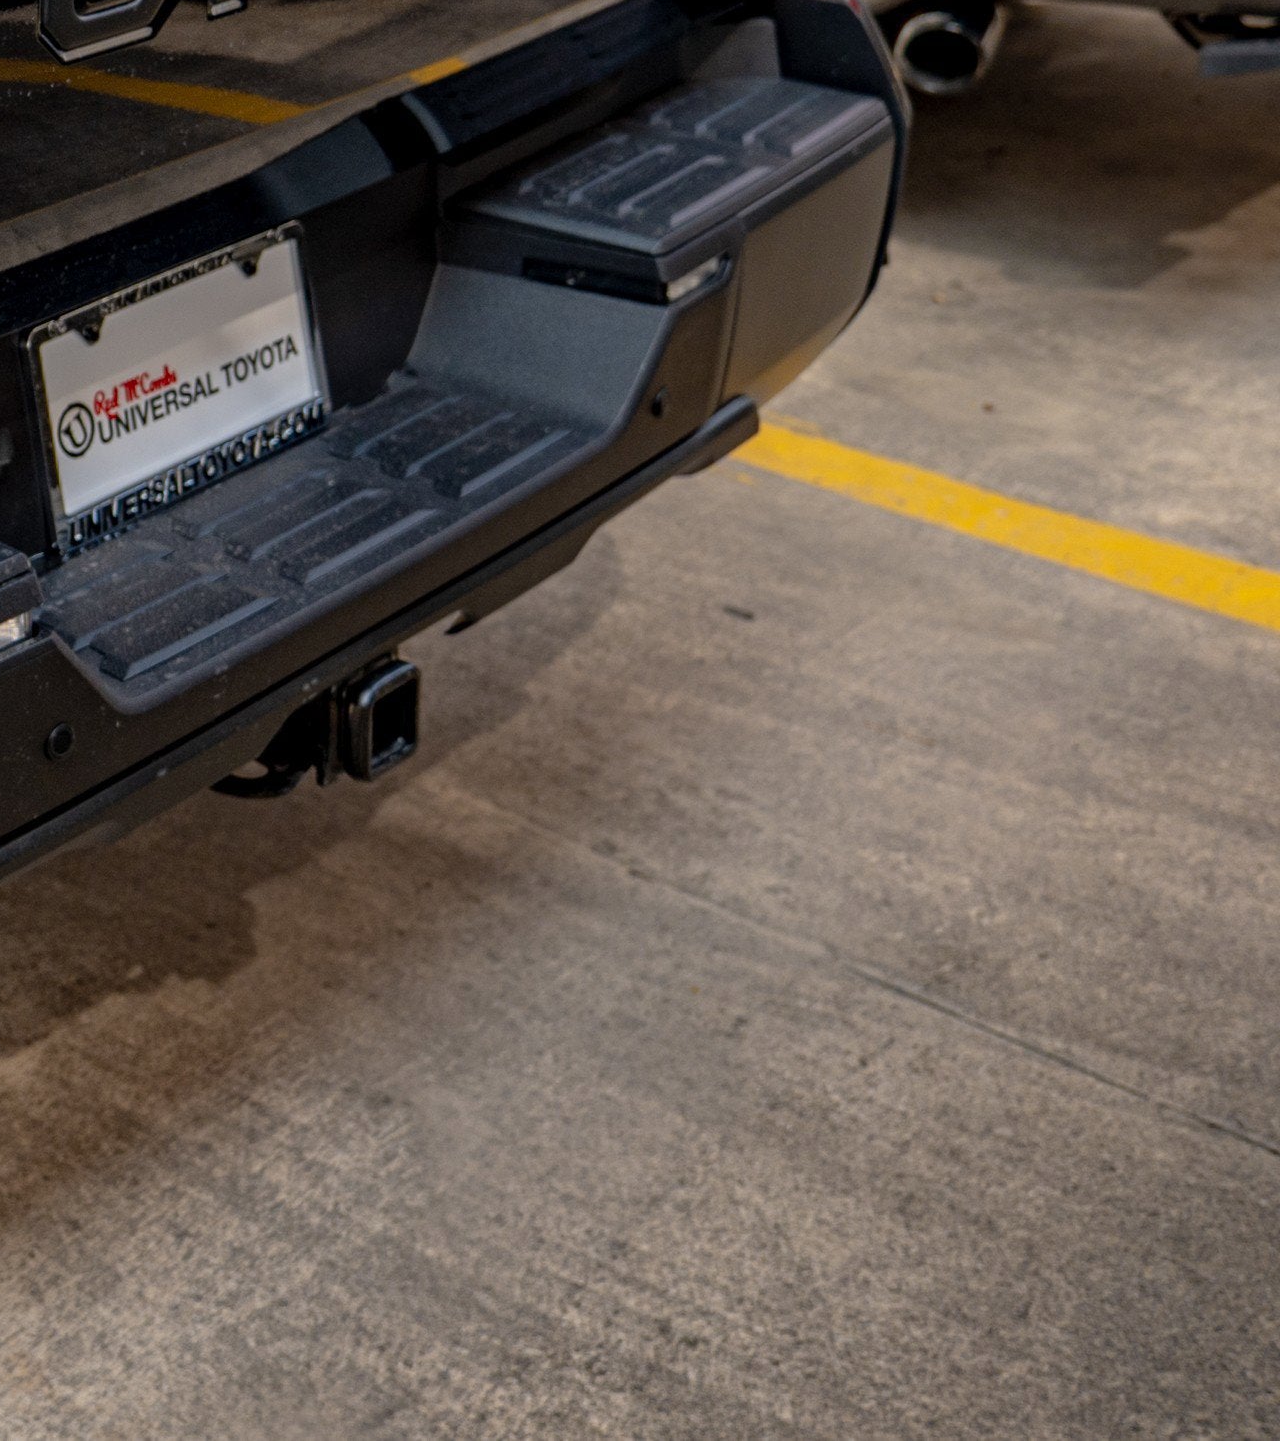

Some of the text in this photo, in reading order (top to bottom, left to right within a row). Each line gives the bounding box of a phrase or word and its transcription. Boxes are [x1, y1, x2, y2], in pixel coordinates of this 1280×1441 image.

[93, 385, 119, 418] Red
[97, 334, 299, 444] UNIVERSAL TOYOTA
